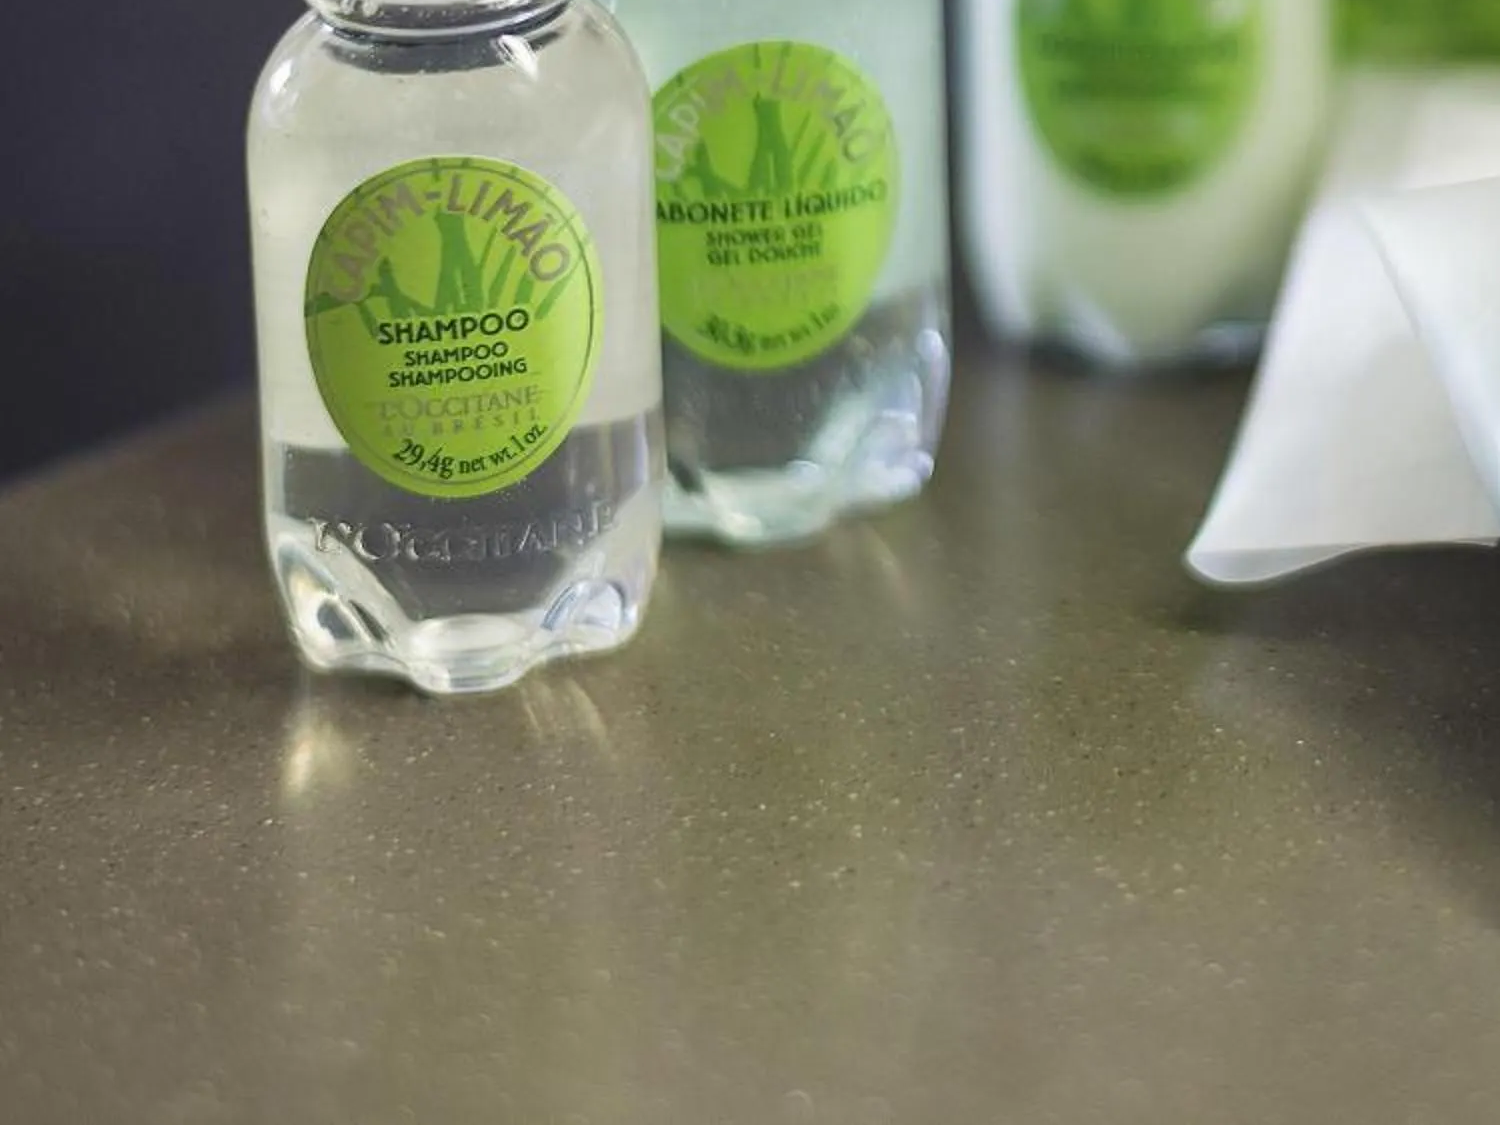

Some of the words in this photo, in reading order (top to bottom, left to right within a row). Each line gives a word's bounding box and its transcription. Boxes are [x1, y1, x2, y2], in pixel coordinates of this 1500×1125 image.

[656, 199, 773, 225] ABONETE
[378, 308, 529, 345] SHAMPOO
[404, 341, 508, 367] SHAMPOO
[388, 357, 528, 388] SHAMPOOING
[391, 437, 456, 480] 29,4g
